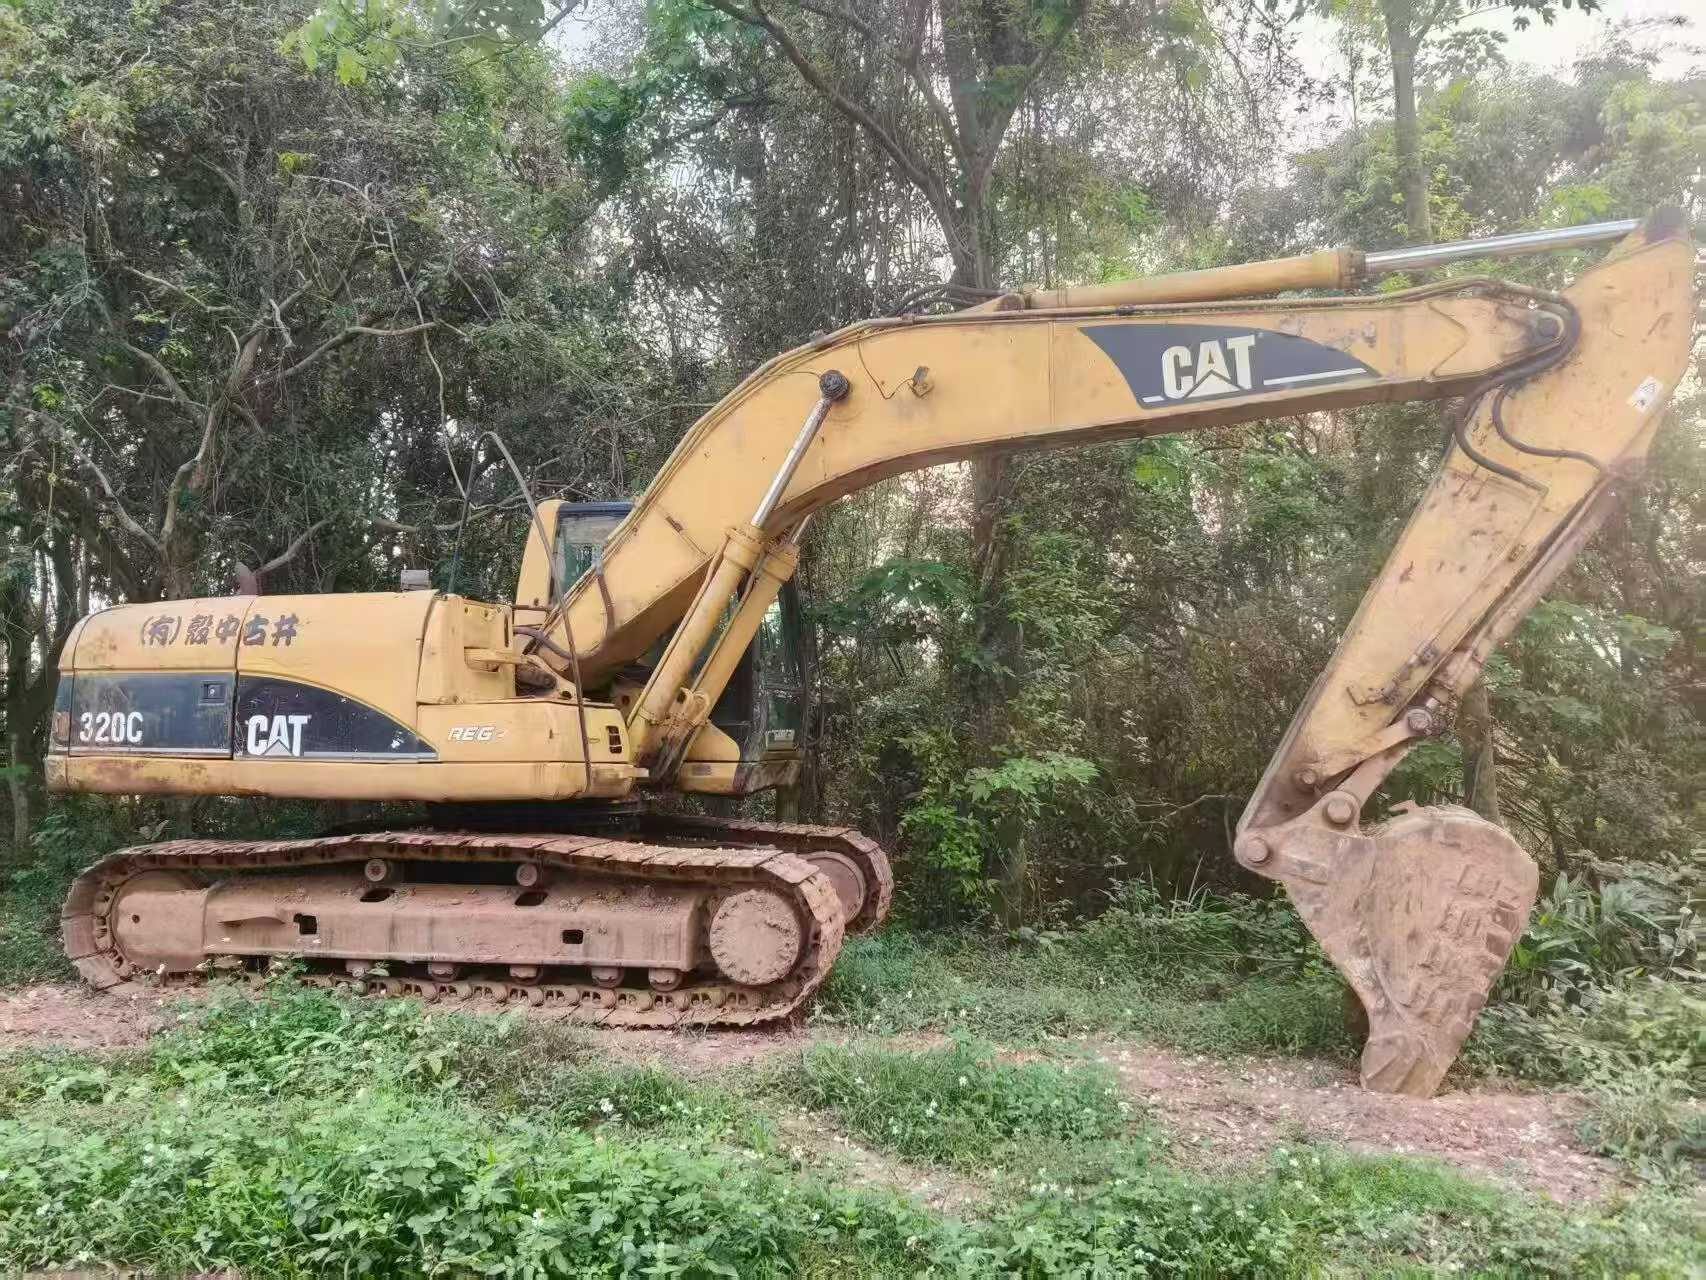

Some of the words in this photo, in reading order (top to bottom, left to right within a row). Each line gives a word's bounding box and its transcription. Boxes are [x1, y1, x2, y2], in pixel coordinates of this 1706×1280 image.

[1162, 334, 1255, 399] CAT
[80, 711, 143, 742] 320C
[247, 715, 308, 757] CAT
